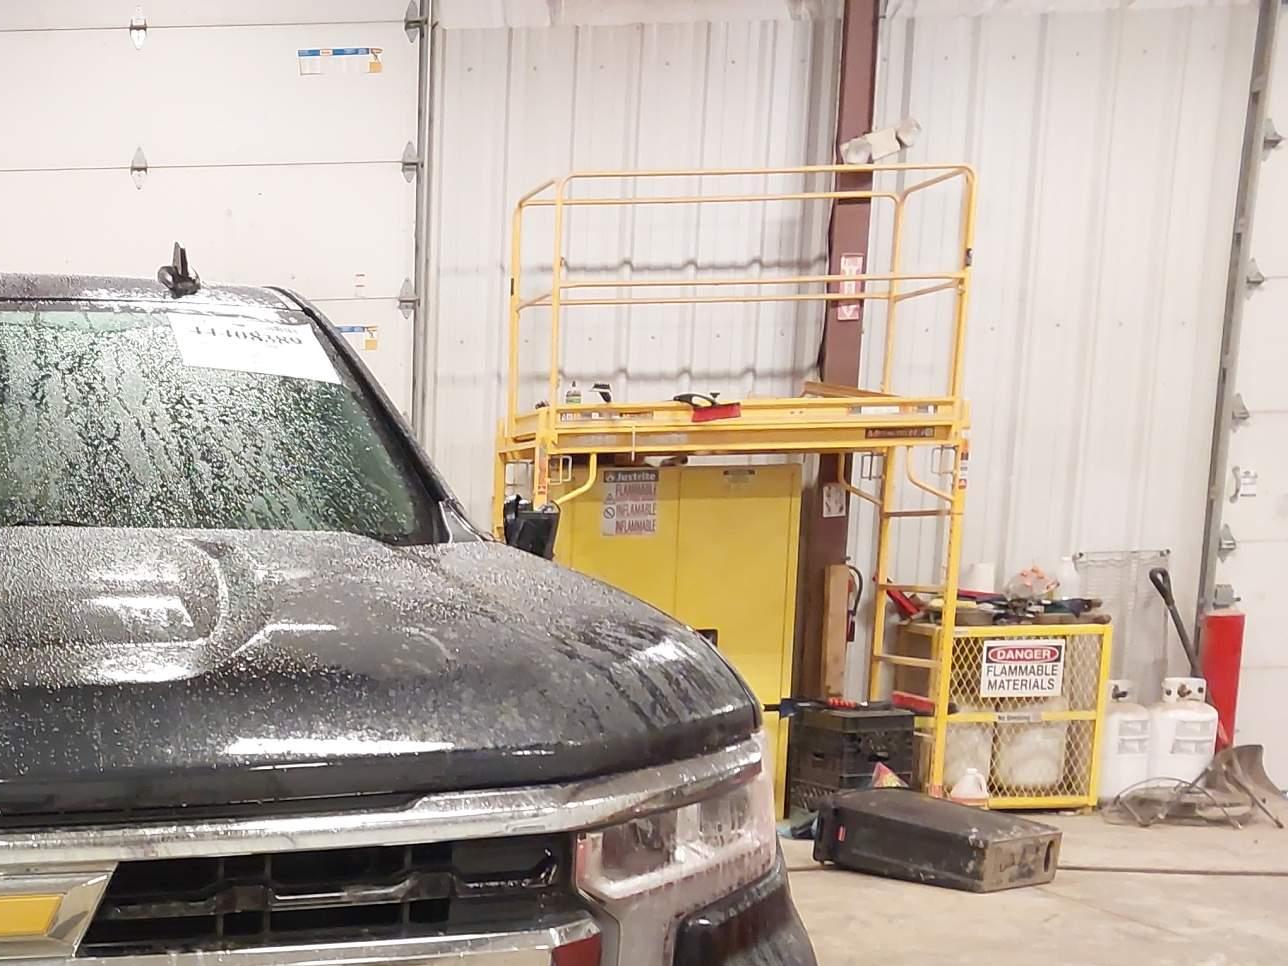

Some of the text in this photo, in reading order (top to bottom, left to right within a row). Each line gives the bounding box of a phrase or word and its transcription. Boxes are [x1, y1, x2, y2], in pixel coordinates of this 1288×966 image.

[996, 649, 1051, 660] DANGER
[986, 664, 1059, 677] FLAMMABLE
[987, 678, 1055, 691] MATERIALS
